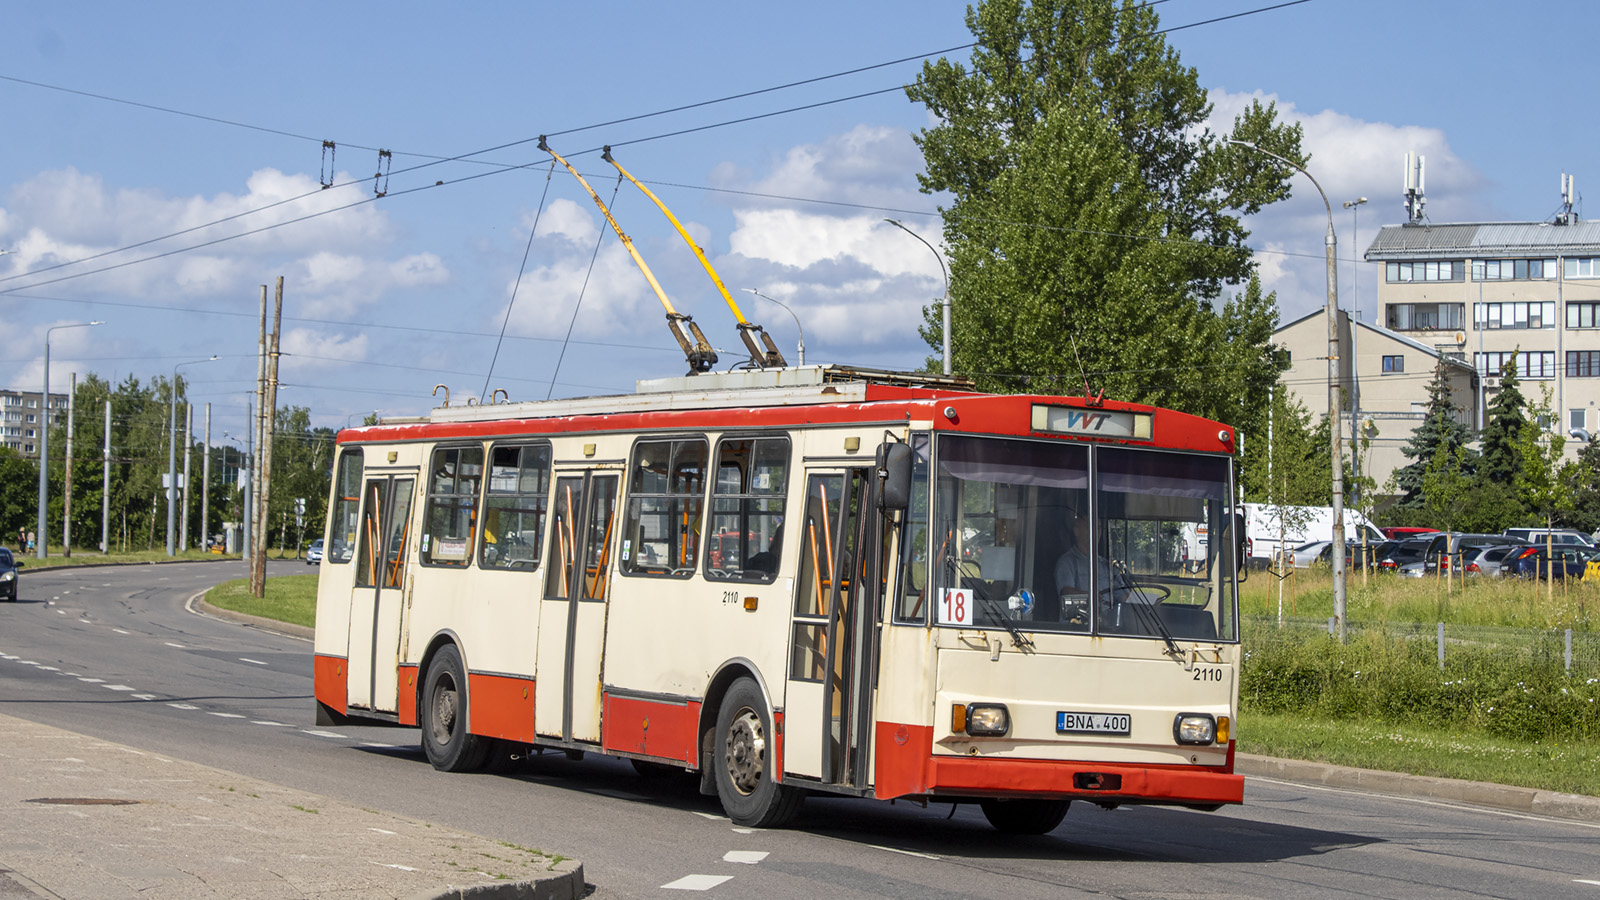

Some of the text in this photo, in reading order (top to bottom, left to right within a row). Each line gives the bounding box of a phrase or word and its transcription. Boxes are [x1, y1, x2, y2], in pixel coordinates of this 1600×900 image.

[722, 591, 739, 604] 2110
[944, 591, 966, 623] 18
[1193, 668, 1222, 682] 2110
[1066, 715, 1127, 731] BNA 400
